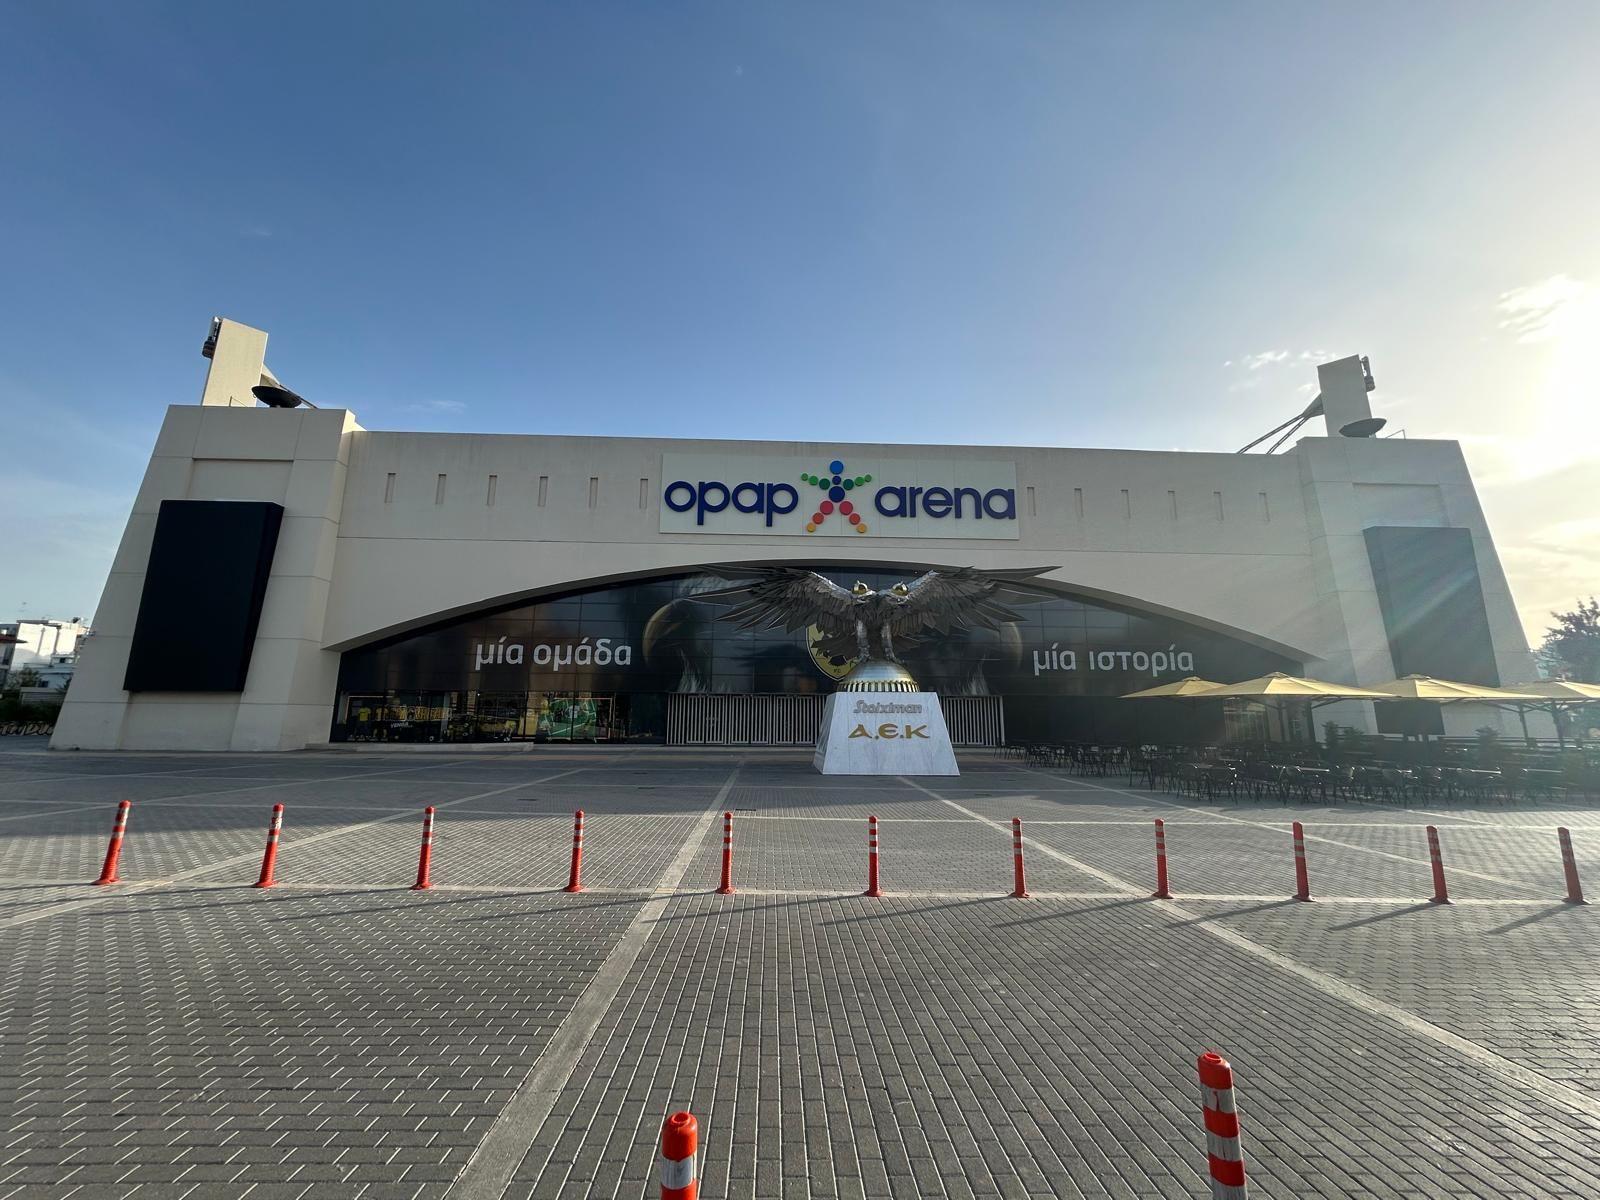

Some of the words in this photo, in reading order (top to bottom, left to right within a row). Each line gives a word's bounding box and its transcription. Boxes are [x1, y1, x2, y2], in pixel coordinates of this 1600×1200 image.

[664, 480, 799, 527] opap
[874, 486, 1016, 520] arena
[475, 636, 524, 671] μία
[533, 636, 632, 672] ομάδα
[1033, 642, 1077, 676] μία
[1089, 643, 1194, 678] ιστορία
